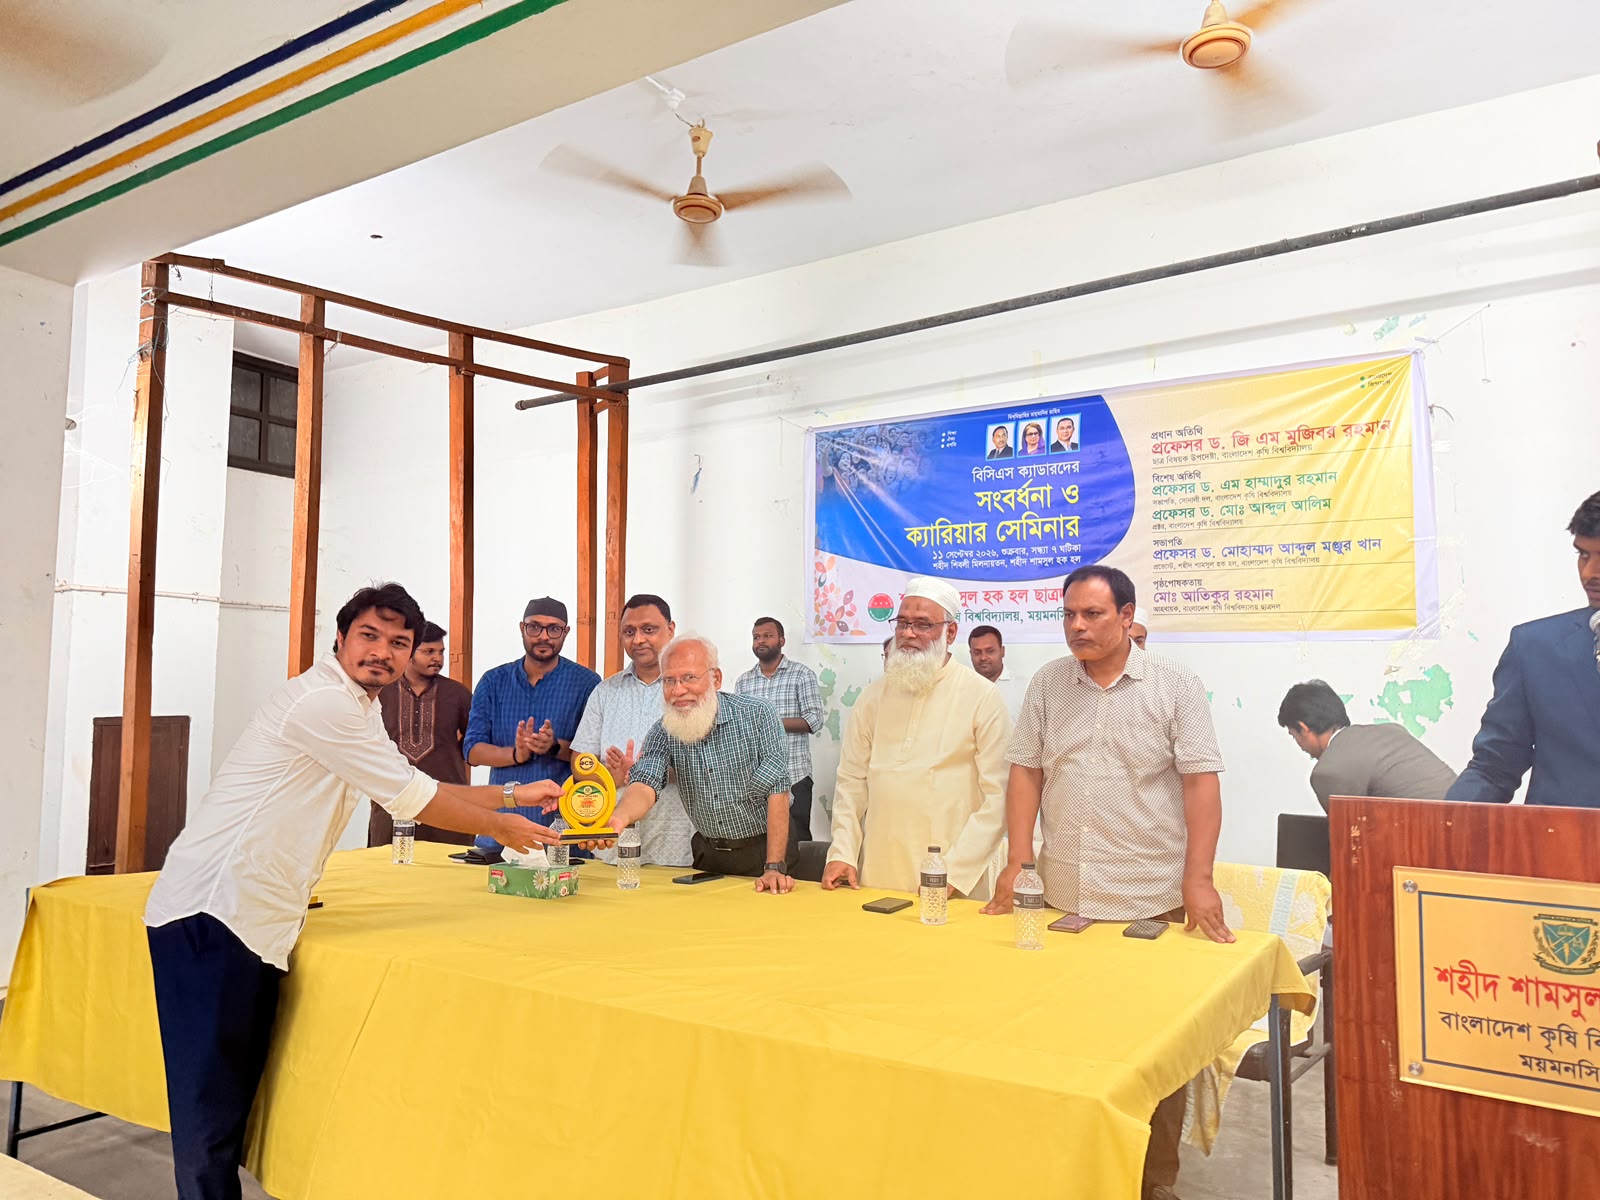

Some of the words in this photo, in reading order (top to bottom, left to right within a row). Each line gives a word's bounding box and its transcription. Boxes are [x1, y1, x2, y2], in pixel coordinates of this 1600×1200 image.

[1151, 430, 1173, 440] প্রধান
[1176, 424, 1203, 437] অতিথি
[1151, 438, 1203, 455] প্রফেসর
[1207, 437, 1225, 450] ড.
[1231, 430, 1250, 448] জি
[1256, 431, 1280, 446] এম
[1285, 424, 1336, 446] মুজিবর
[1341, 419, 1392, 438] রহমান
[1221, 449, 1253, 459] বাংলাদেশ
[1256, 446, 1270, 457] কৃষি
[1272, 443, 1312, 455] বিশ্ববিদ্যালয়
[971, 465, 1014, 483] বিসিএস
[1017, 460, 1080, 480] ক্যাডারদের
[1152, 472, 1175, 483] বিশেষ
[1177, 470, 1201, 481] অতিথি
[1152, 483, 1196, 497] প্রফেসর
[1200, 481, 1214, 492] ড.
[1220, 478, 1241, 491] এম
[1244, 474, 1292, 489] হাম্মাদুর
[1296, 469, 1338, 486] রহমান
[974, 478, 1053, 513] সংবর্ধনা
[1061, 484, 1080, 504] ও
[1152, 507, 1195, 521] প্রফেসর
[1199, 506, 1214, 518] ড.
[1220, 504, 1245, 517] মোঃ
[1249, 501, 1287, 517] আব্দুল
[1291, 495, 1332, 512] আলিম
[904, 517, 988, 548] ক্যারিয়ার
[996, 510, 1082, 542] সেমিনার
[932, 550, 943, 560] ১১
[945, 548, 974, 559] সেপ্টেম্বর
[1051, 546, 1057, 554] ৭
[1059, 542, 1081, 553] ঘটিকা
[1152, 536, 1183, 548] সভাপতি
[1152, 548, 1197, 561] প্রফেসর
[1201, 547, 1216, 559] ড.
[1222, 544, 1274, 559] মোহাম্মদ
[1278, 541, 1316, 557] আব্দুল
[1357, 537, 1382, 551] খান
[932, 559, 949, 570] শহীদ
[1010, 556, 1027, 567] শহীদ
[1029, 555, 1054, 567] শামসুল
[1056, 556, 1067, 565] হক
[1070, 555, 1081, 564] হল
[1152, 577, 1203, 591] পৃষ্ঠপোষকতায়
[982, 590, 1004, 606] হক
[1008, 589, 1029, 605] হল
[1033, 587, 1064, 604] ছাত্র
[1153, 591, 1177, 603] মোঃ
[1181, 587, 1230, 605] আতিকুর
[1234, 588, 1274, 602] রহমান
[964, 608, 1024, 624] বিশ্ববিদ্যালয়,
[1433, 959, 1500, 1003] শহীদ
[1438, 1011, 1532, 1042] বাংলাদেশ
[1537, 1023, 1579, 1054] কৃষি
[1518, 1053, 1600, 1083] ময়মনসি
